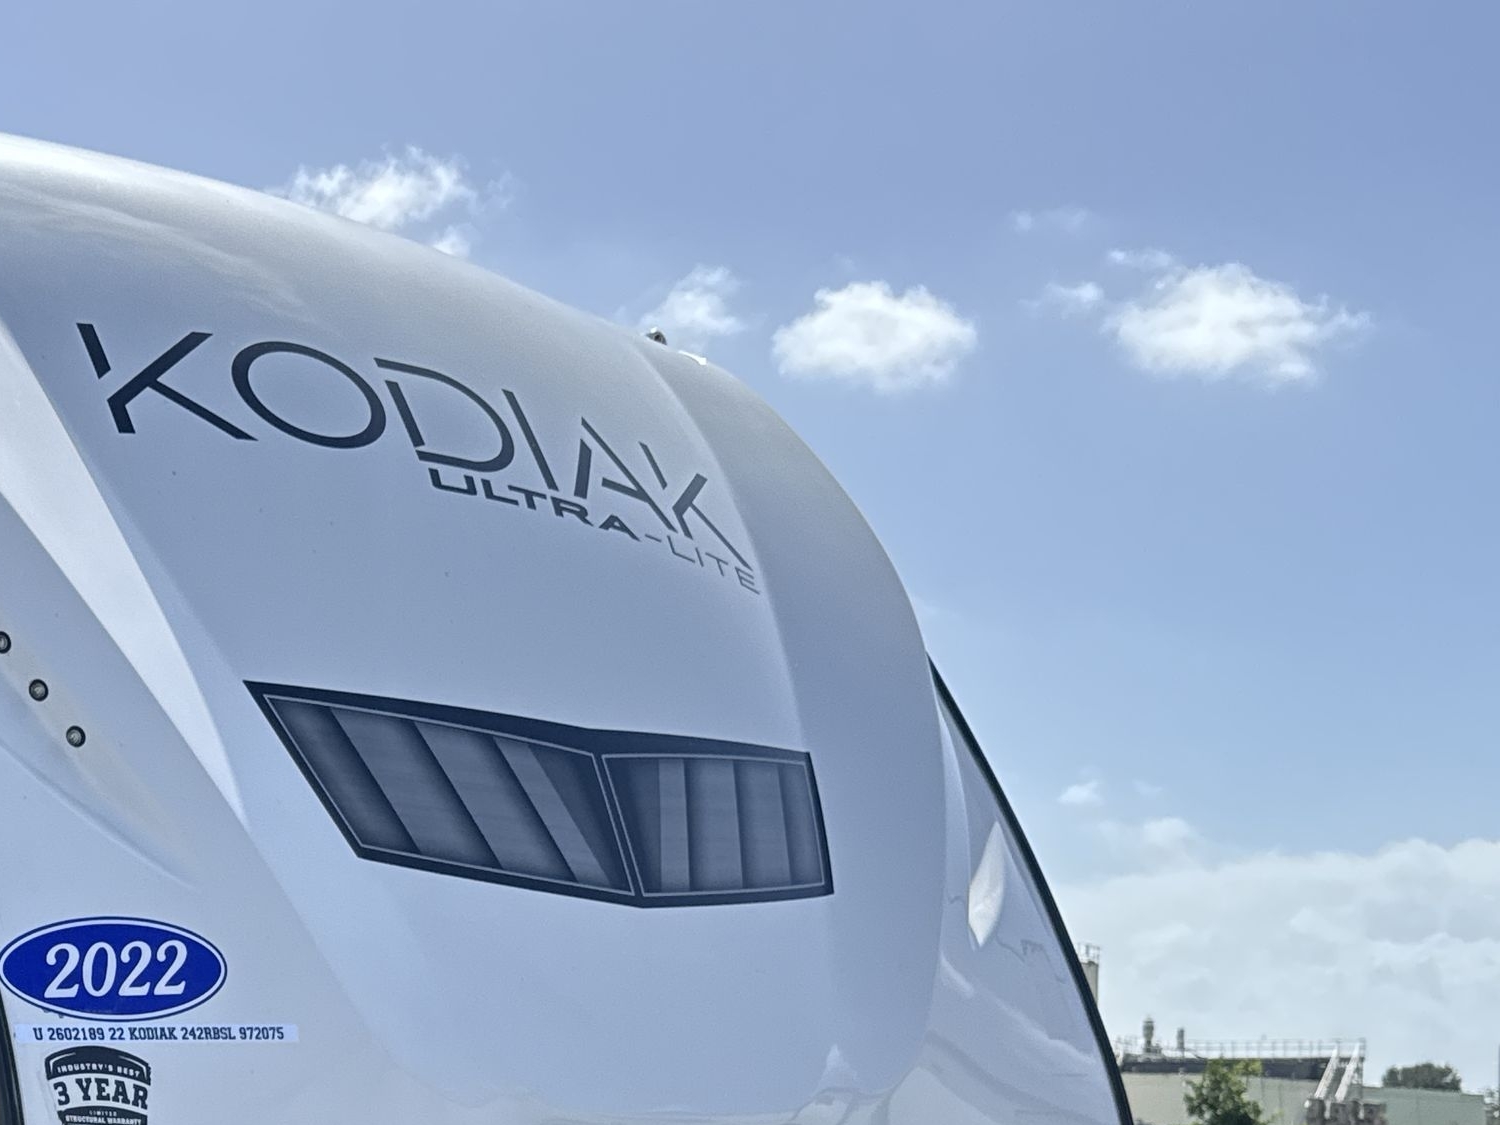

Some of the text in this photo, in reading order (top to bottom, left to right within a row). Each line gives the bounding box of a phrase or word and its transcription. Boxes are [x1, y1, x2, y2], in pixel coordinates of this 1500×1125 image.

[76, 322, 752, 571] KODIAK
[427, 467, 761, 596] ULTRA-LITE
[44, 940, 188, 999] 2022
[32, 1026, 284, 1041] U 2602189 22 KODIAK 242RBSL 972075
[57, 1062, 141, 1078] INDUSTRY'S BEST
[53, 1077, 148, 1111] 3 YEAR
[65, 1115, 142, 1125] STRUCTURAL WARRANTY
